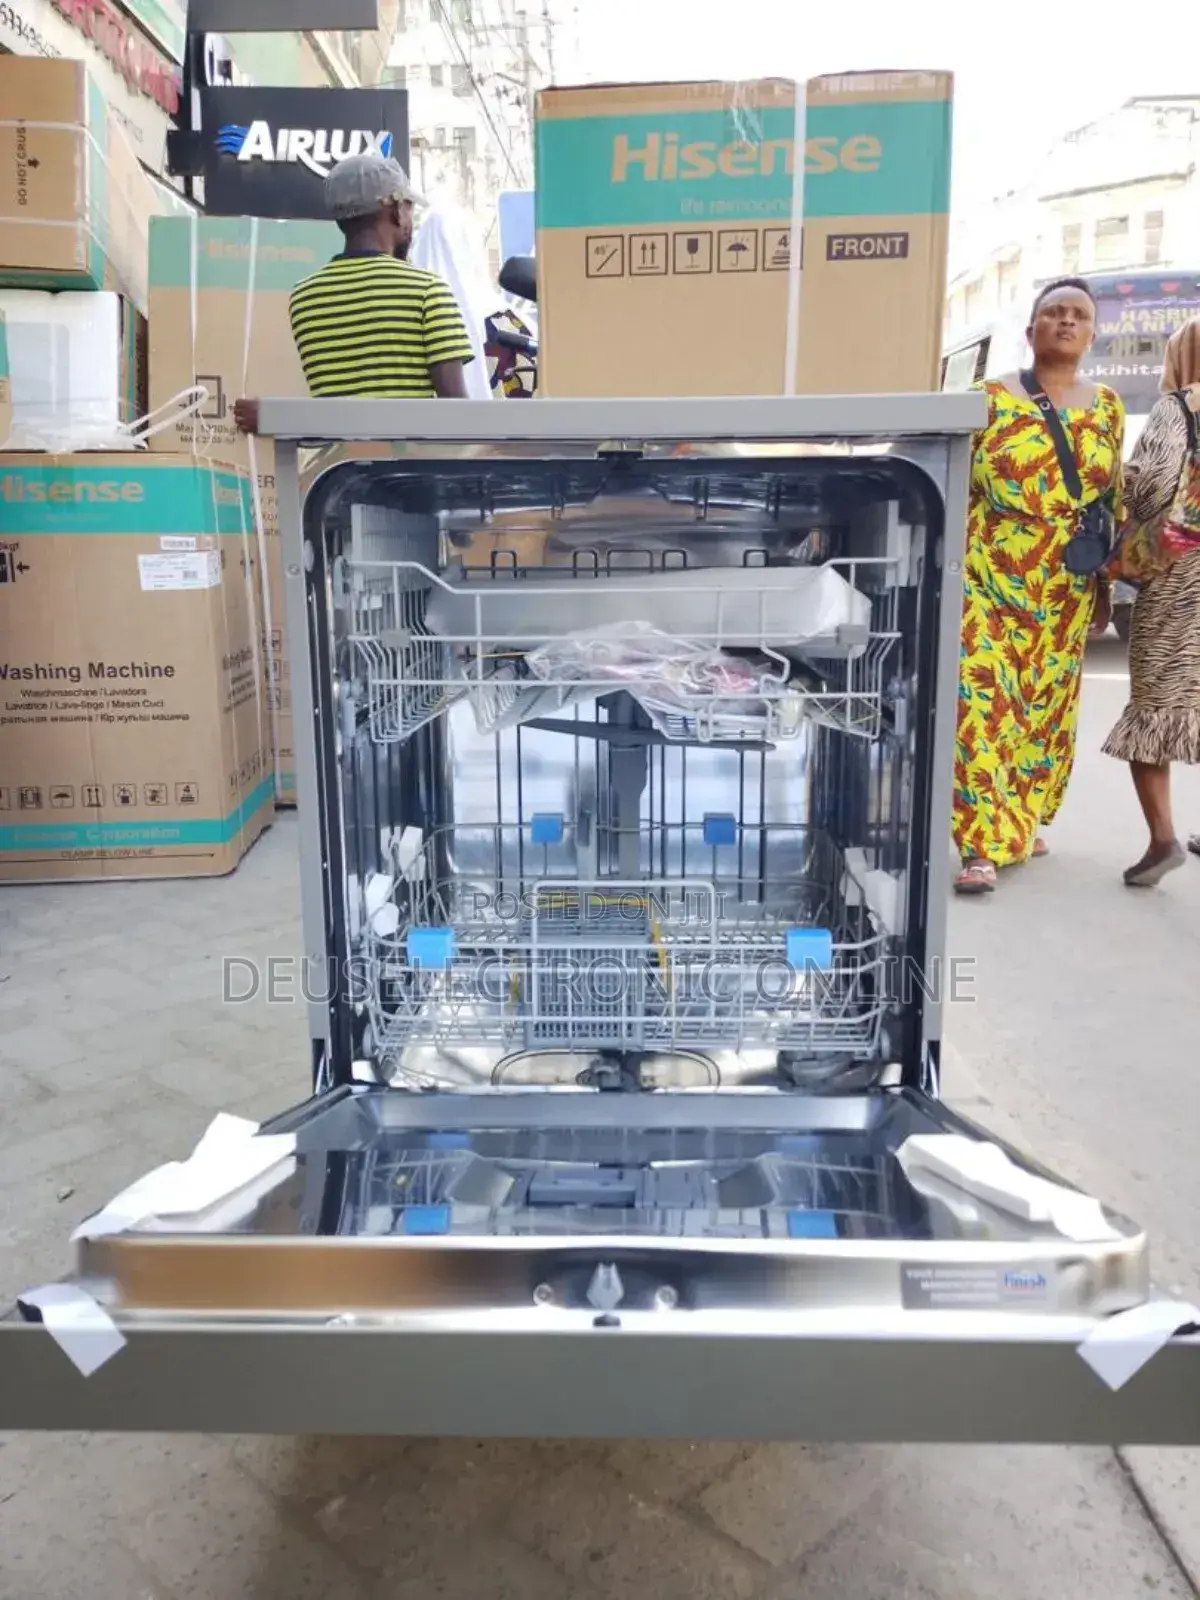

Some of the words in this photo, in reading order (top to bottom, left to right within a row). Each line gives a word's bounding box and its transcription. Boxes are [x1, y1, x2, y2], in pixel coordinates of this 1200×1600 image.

[237, 120, 391, 178] AIRLUX
[611, 132, 882, 183] Hisense
[831, 236, 905, 257] FRONT
[88, 662, 175, 679] Machine
[20, 688, 98, 698] Waschmaschine
[104, 687, 147, 697] Lavadora
